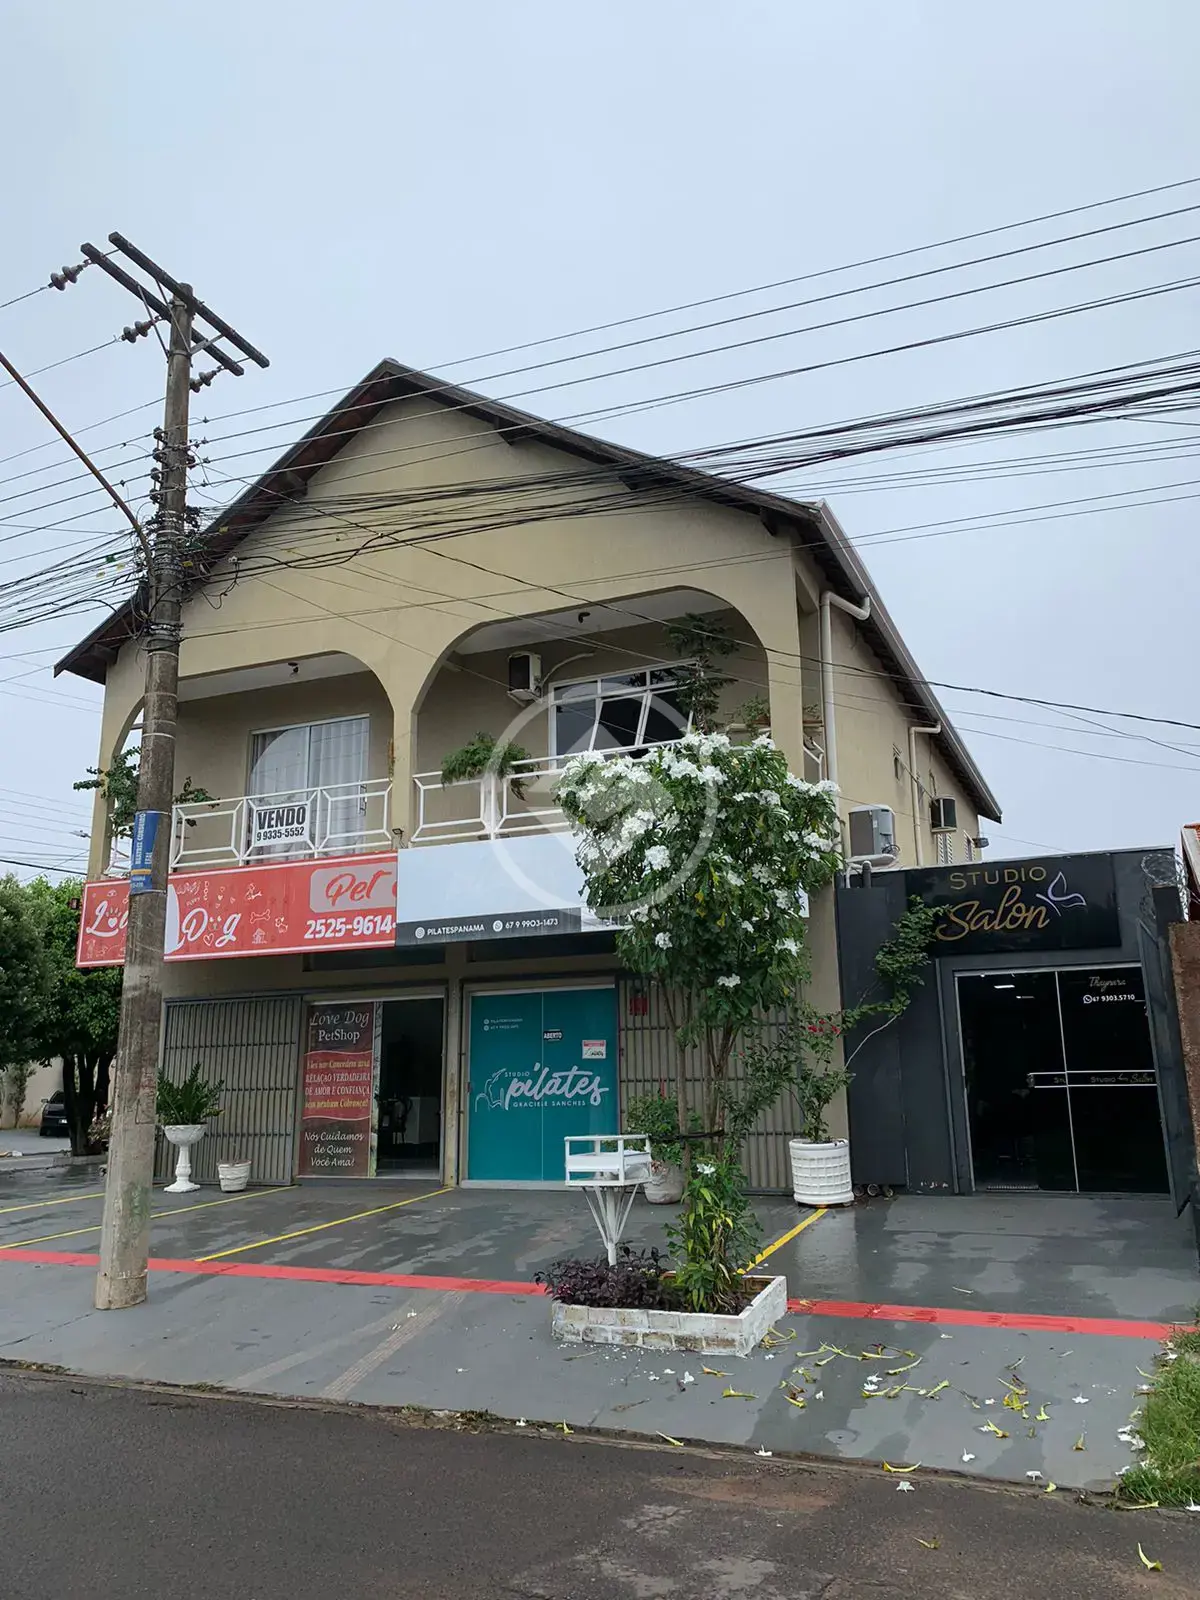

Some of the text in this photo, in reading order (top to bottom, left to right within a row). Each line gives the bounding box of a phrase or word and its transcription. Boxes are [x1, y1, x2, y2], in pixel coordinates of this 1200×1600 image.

[257, 806, 306, 830] VENDO
[256, 826, 305, 841] 9 9335-5552
[949, 866, 1047, 890] STUDIO
[325, 869, 393, 907] Pet
[935, 885, 1050, 941] Salon
[427, 924, 485, 936] PILATESPANAMA
[521, 918, 559, 928] 9903-1473
[310, 1010, 370, 1028] Love Dog
[318, 1028, 360, 1044] PetShop
[333, 1072, 370, 1082] VERDADEIRA
[305, 1086, 314, 1096] DE
[314, 1086, 331, 1096] AMOR
[504, 1062, 610, 1111] pilates
[513, 1099, 587, 1108] GRACIELE SANCHES
[305, 1130, 365, 1141] Nós Cuidamos
[314, 1144, 353, 1155] de Quem
[311, 1156, 330, 1167] Você
